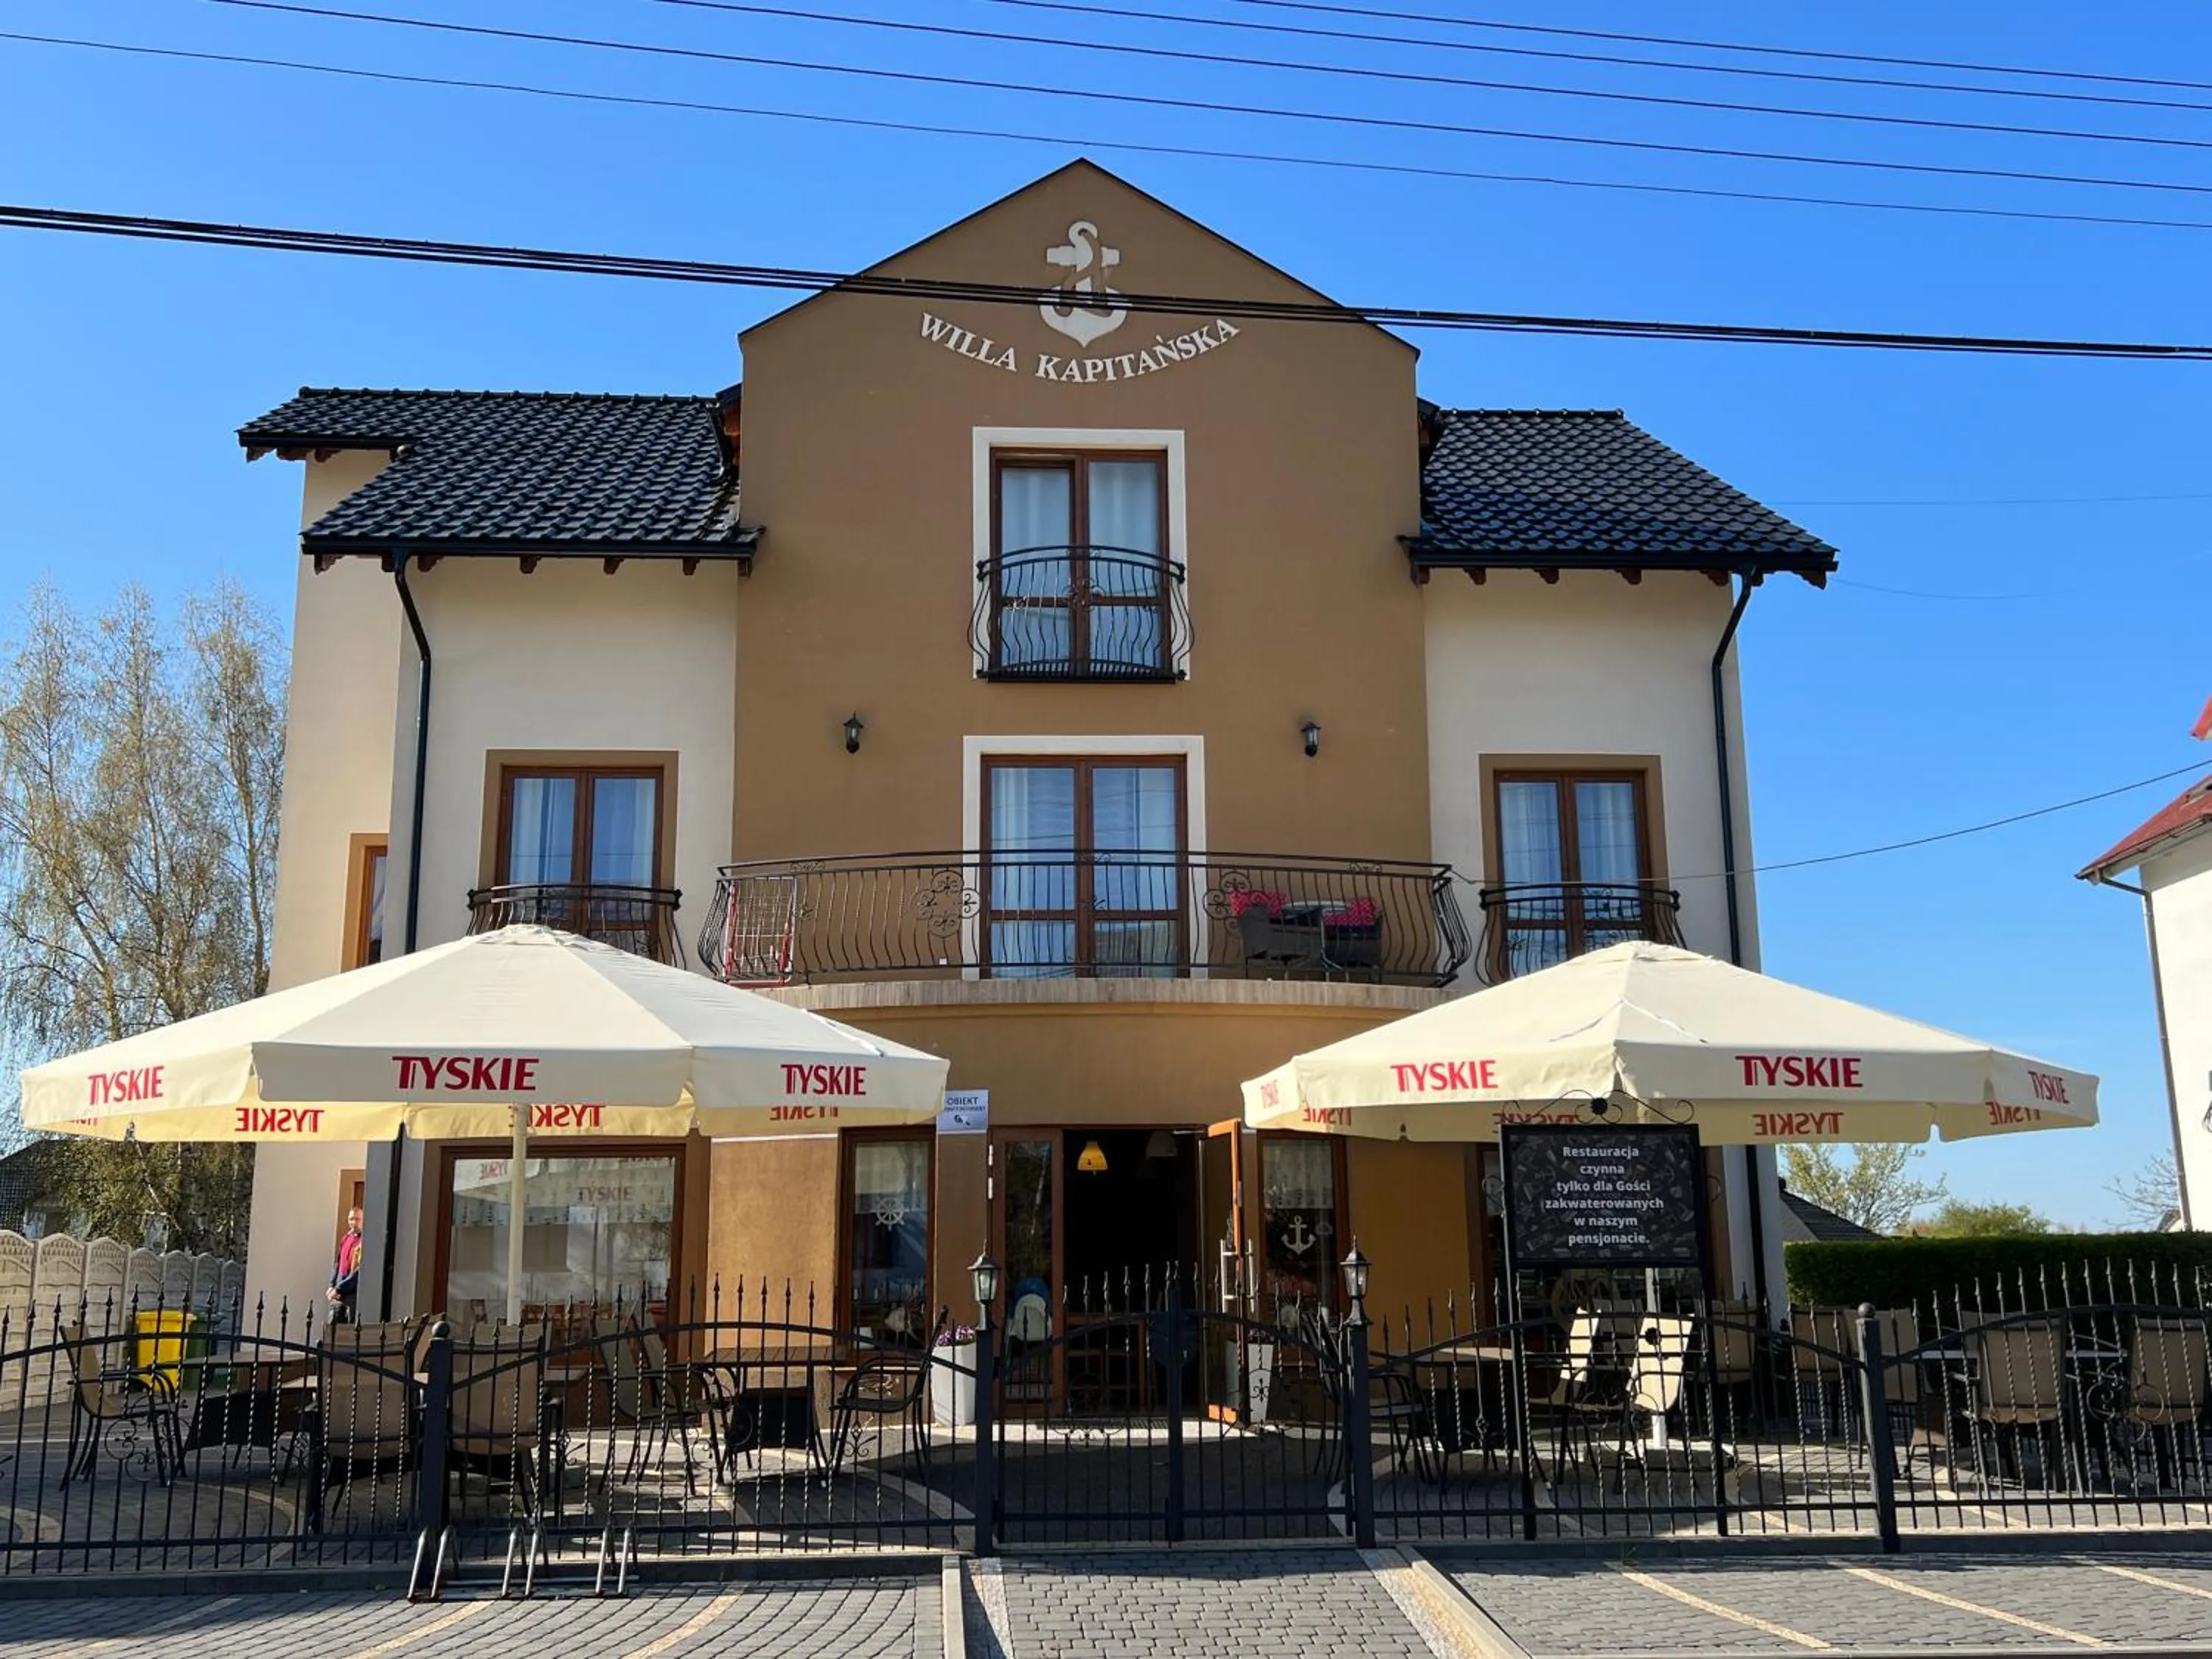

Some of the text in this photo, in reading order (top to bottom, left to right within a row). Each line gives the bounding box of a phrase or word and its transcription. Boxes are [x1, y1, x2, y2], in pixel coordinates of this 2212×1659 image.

[920, 313, 1240, 383] WILLA KAPITAŃSKA
[392, 1056, 540, 1091] TYSKIE
[780, 1064, 866, 1095] TYSKIE
[1389, 1060, 1498, 1092] TYSKIE
[1735, 1055, 1863, 1088] TYSKIE
[87, 1065, 164, 1105] TYSKIE
[2028, 1071, 2070, 1104] TYSKIE
[947, 1096, 978, 1106] OBIEKT
[1563, 1147, 1639, 1158] Restauracja
[1580, 1164, 1624, 1177] czynna
[1557, 1180, 1651, 1194] tylko dla Gości
[1545, 1197, 1664, 1211] zakwaterowanych
[1573, 1217, 1638, 1228] w naszym
[1568, 1232, 1649, 1247] pensjonacie.
